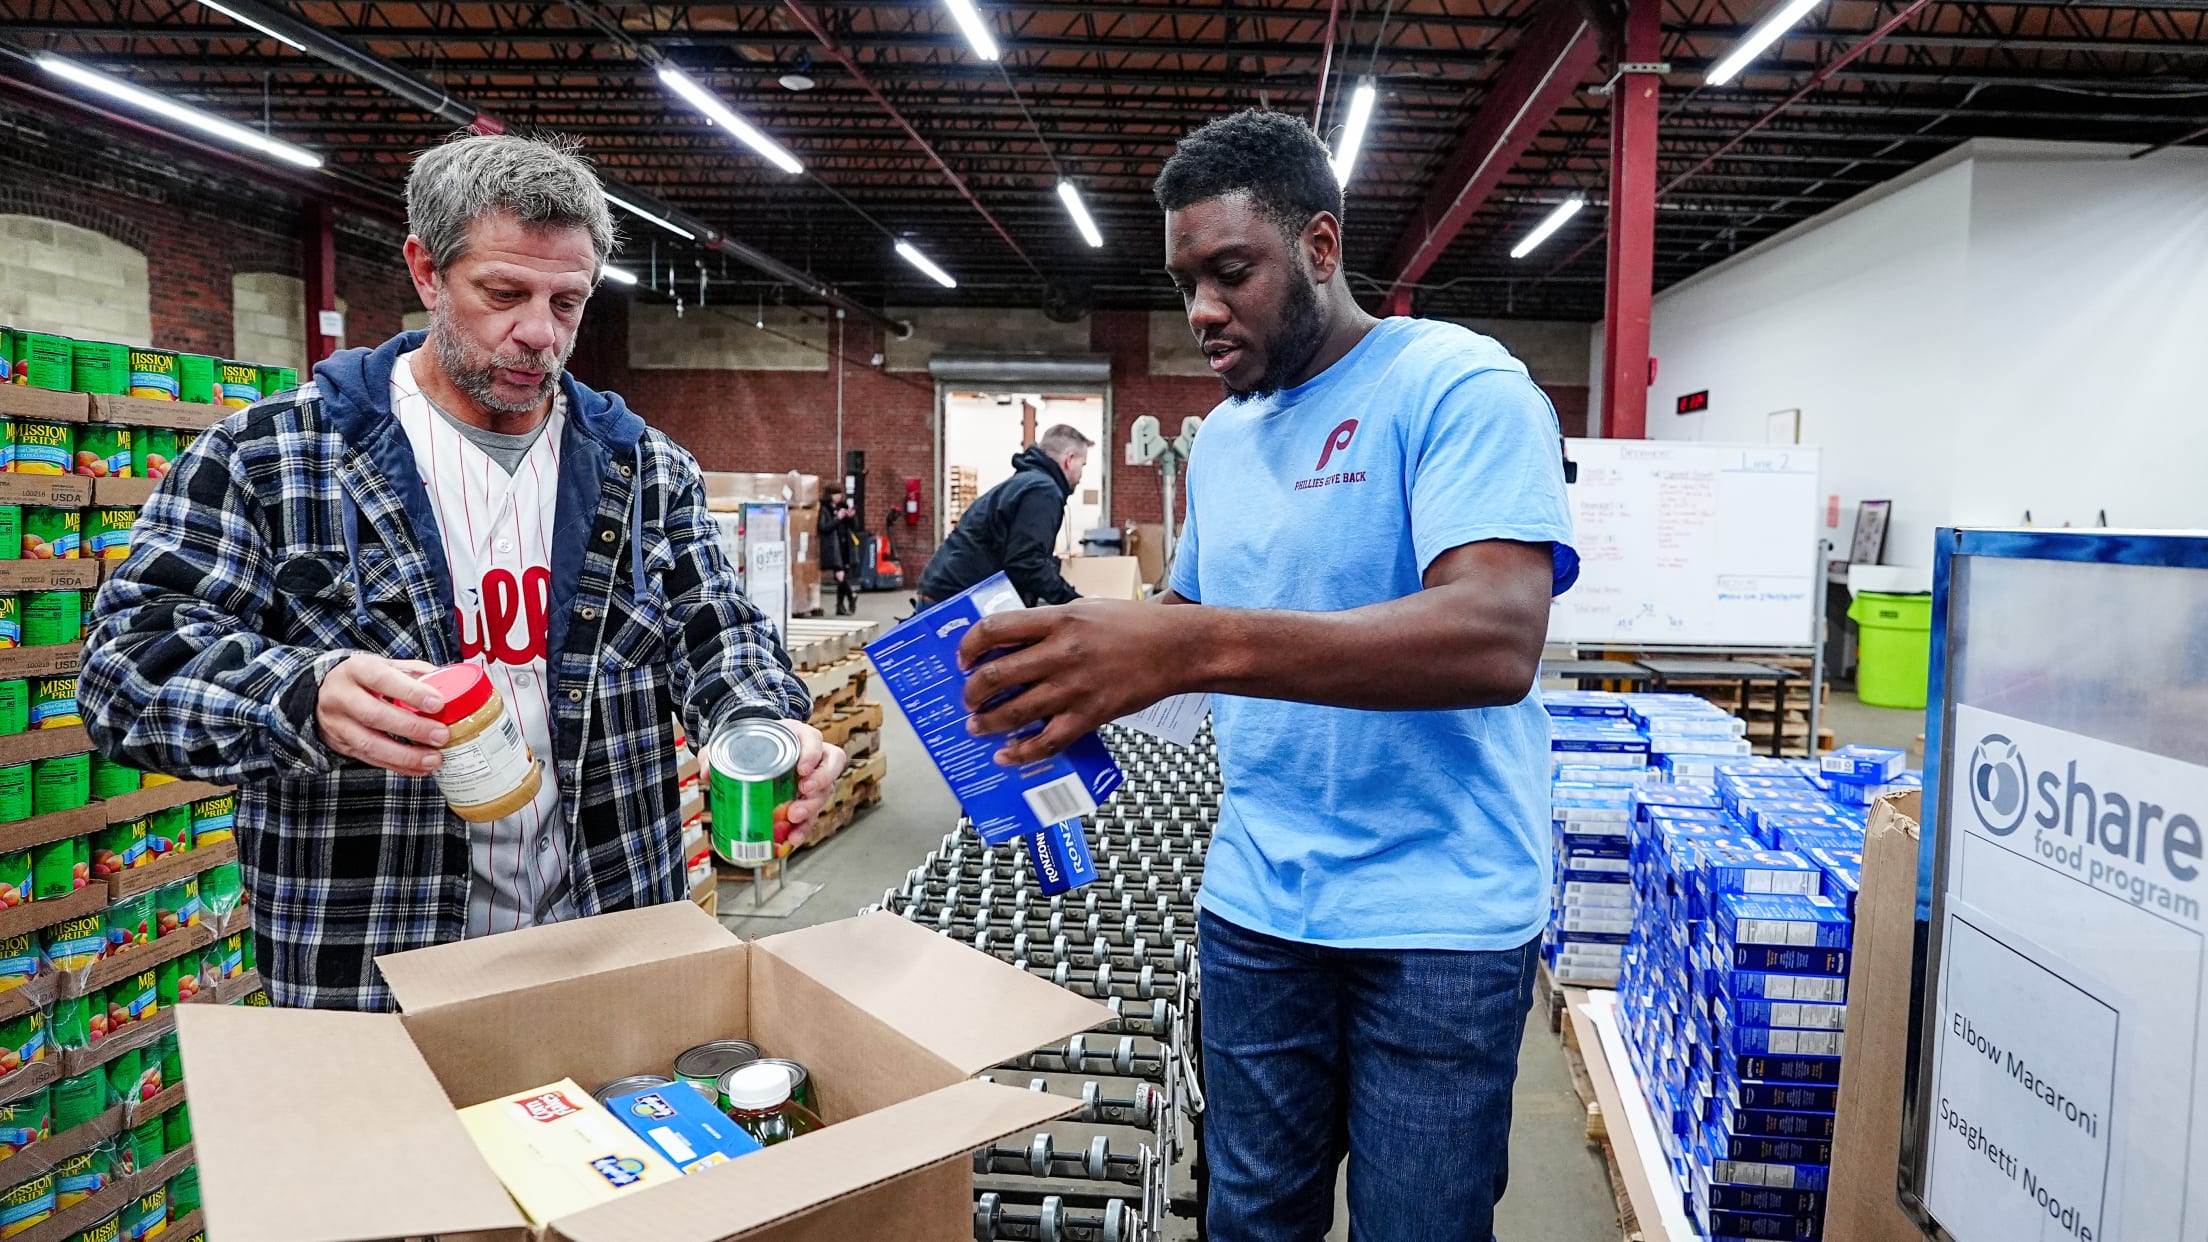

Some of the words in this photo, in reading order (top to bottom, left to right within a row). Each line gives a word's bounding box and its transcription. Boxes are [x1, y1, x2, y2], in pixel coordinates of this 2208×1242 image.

[134, 364, 167, 374] PRIDE
[15, 423, 67, 444] MISSION
[23, 436, 59, 446] PRIDE
[1315, 418, 1359, 472] P
[1779, 453, 1790, 470] 2
[1294, 478, 1324, 491] PHILLIES
[1324, 473, 1341, 486] GIVE
[1342, 471, 1367, 483] BACK
[51, 493, 81, 503] USDA
[51, 578, 82, 586] USDA
[195, 796, 233, 817] MISSION
[2034, 759, 2204, 882] share
[1036, 832, 1059, 883] RONZONI
[2033, 829, 2083, 871] food
[2089, 858, 2200, 921] program
[47, 916, 100, 939] MISSION
[58, 930, 92, 942] PRIDE
[1953, 1012, 2002, 1065] Elbow
[2006, 1051, 2098, 1139] Macaroni
[1940, 1098, 2018, 1181] Spaghetti
[2022, 1168, 2093, 1242] Noodle
